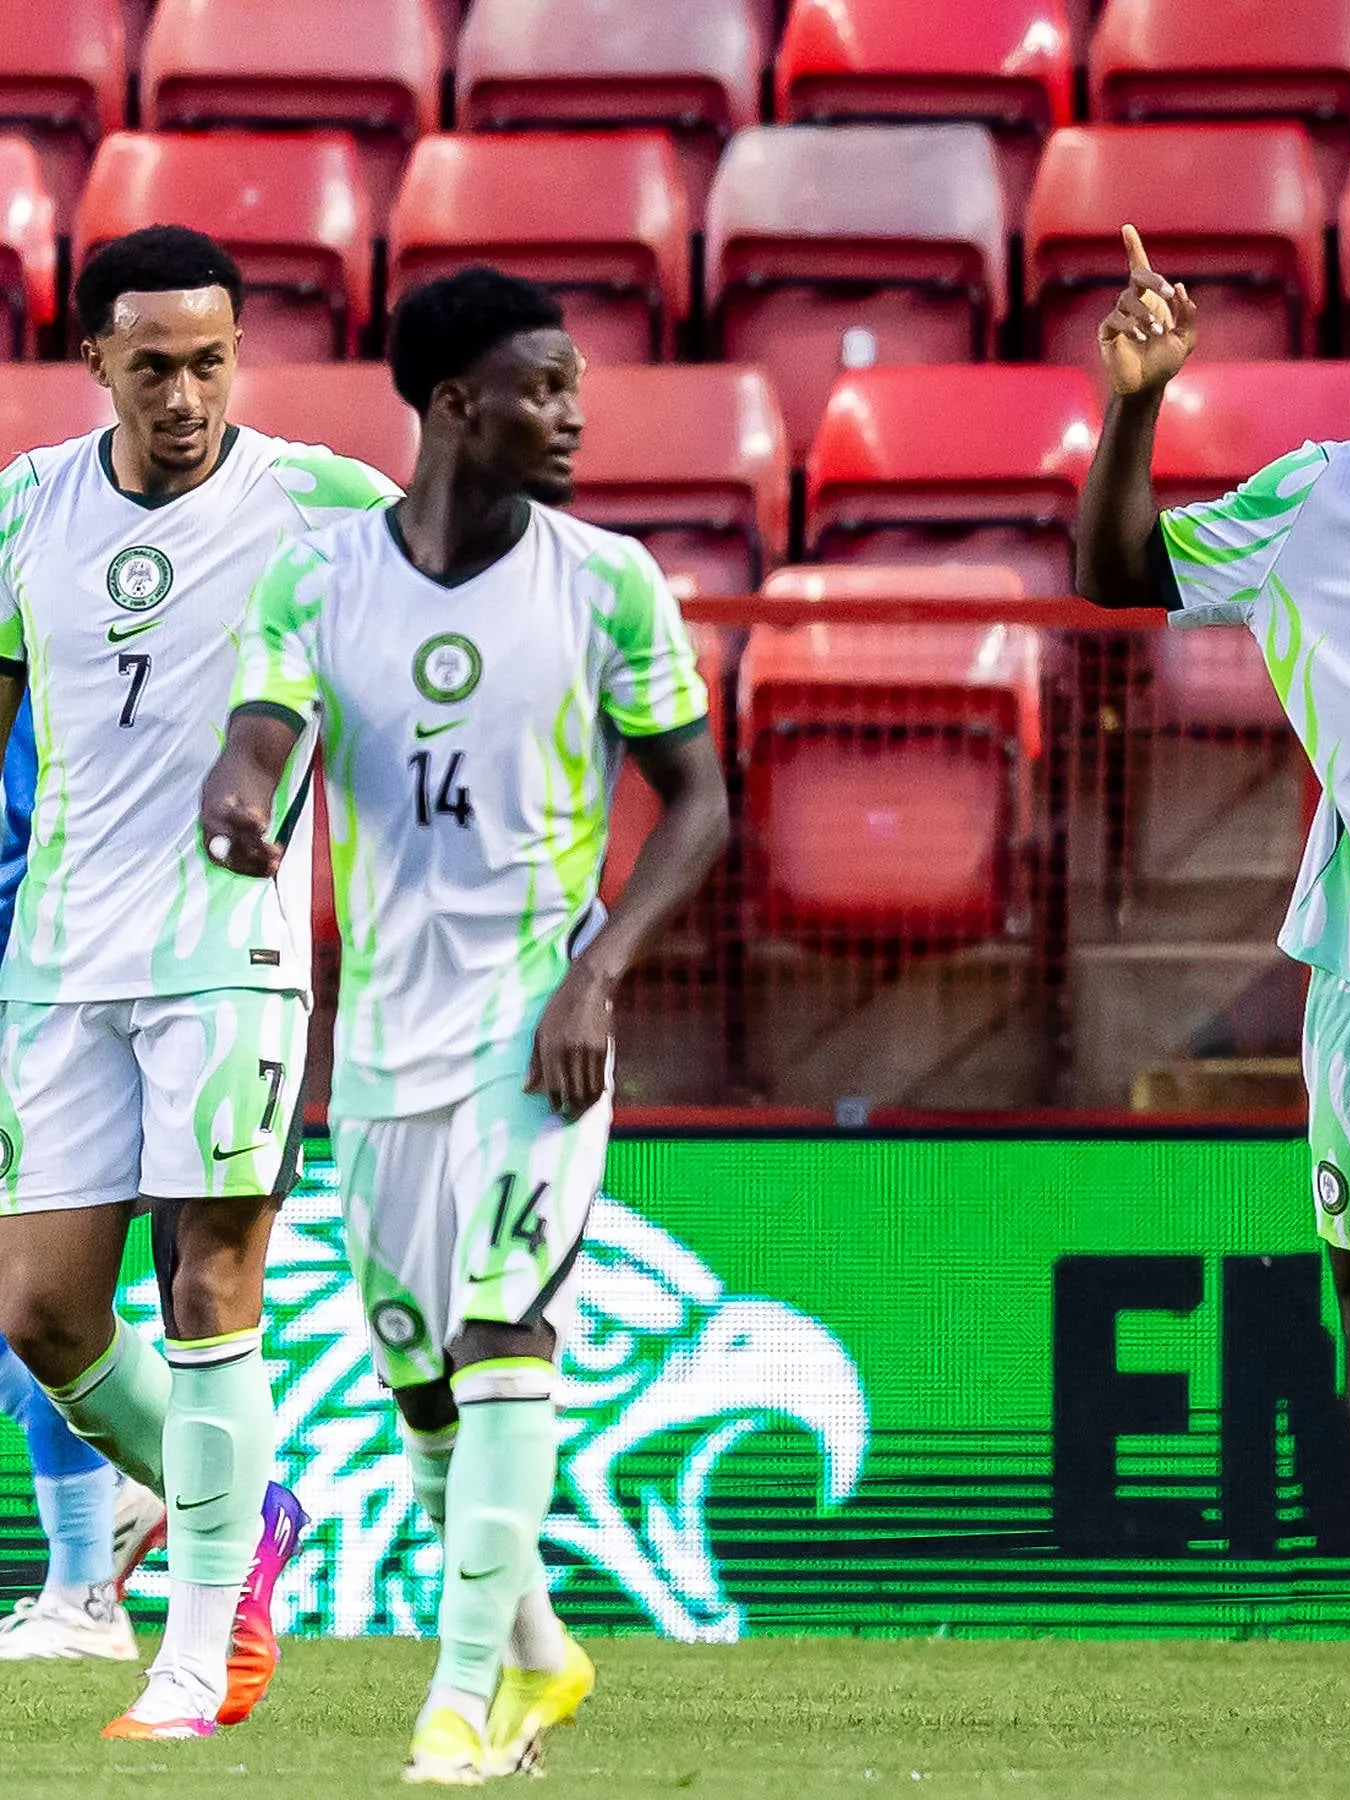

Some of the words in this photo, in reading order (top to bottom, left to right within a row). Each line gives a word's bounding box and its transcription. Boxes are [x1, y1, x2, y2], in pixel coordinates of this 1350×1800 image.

[118, 654, 152, 728] 7
[406, 750, 476, 829] 14
[259, 1059, 286, 1133] 7
[490, 1173, 550, 1255] 14
